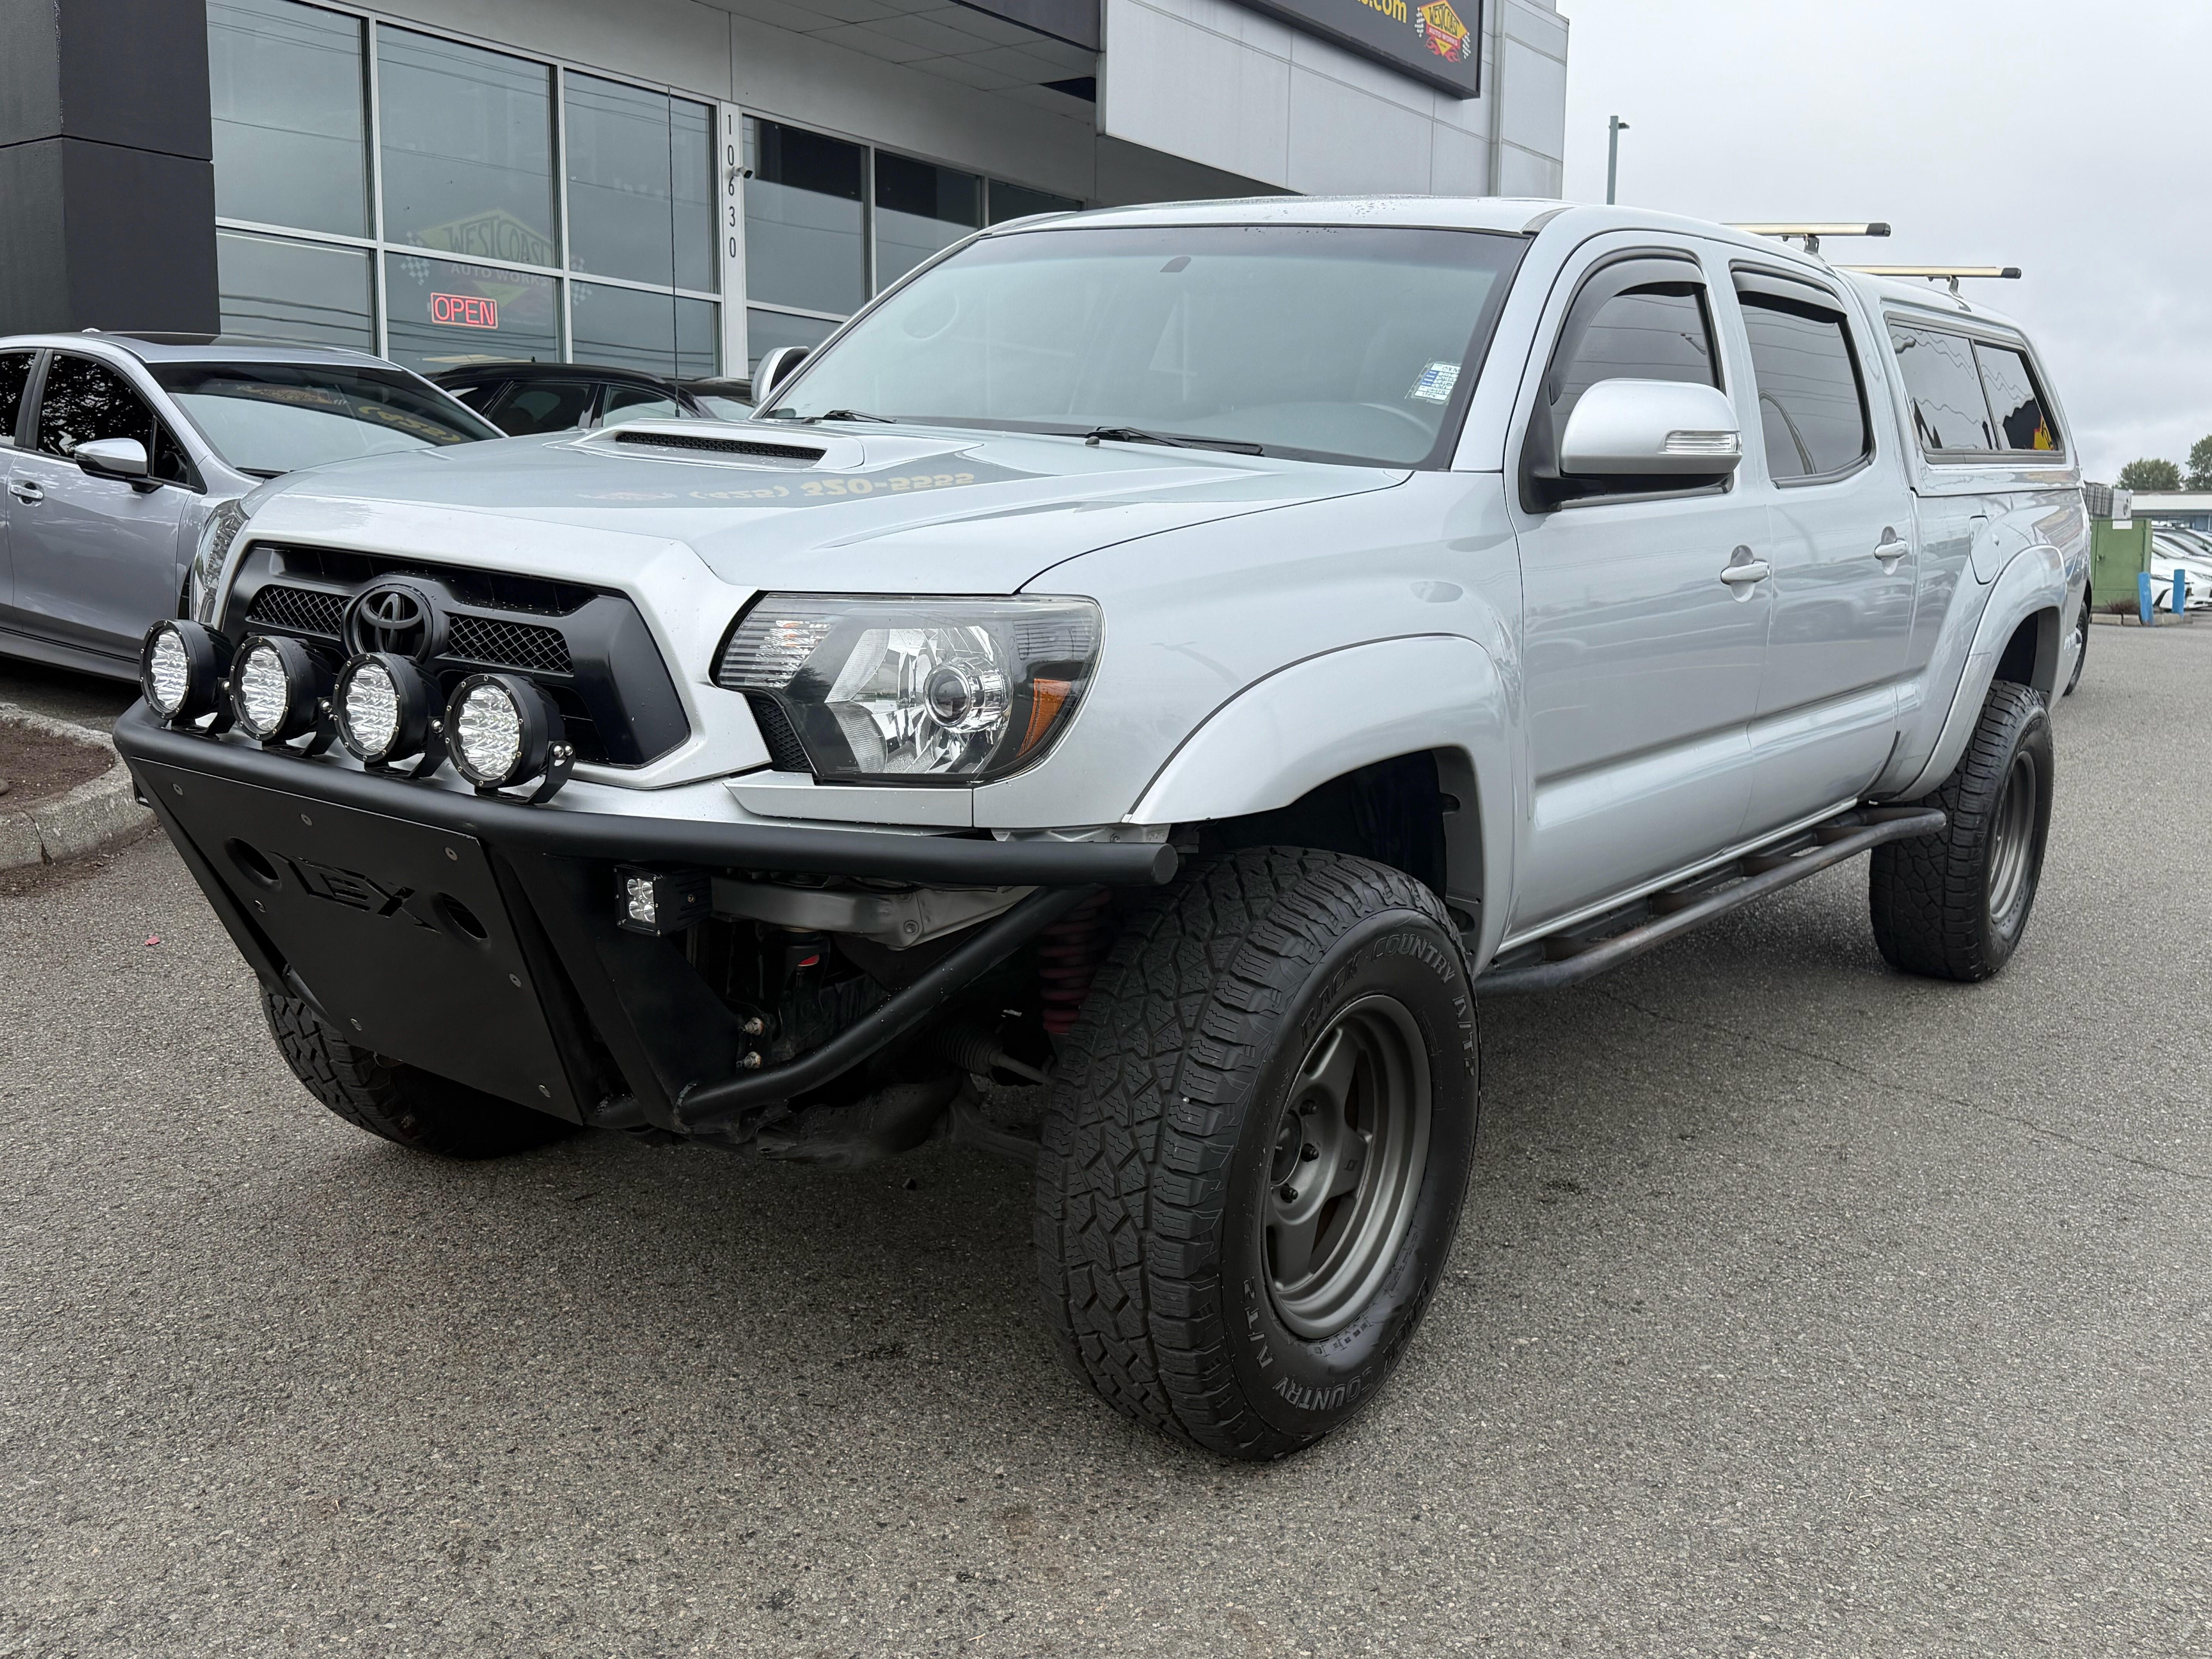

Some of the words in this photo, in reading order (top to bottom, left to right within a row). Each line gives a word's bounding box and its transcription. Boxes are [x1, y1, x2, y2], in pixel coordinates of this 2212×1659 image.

[1357, 0, 1407, 23] .com
[1429, 27, 1442, 38] AUTO
[1442, 33, 1458, 46] WORKS
[727, 114, 737, 258] 10630
[451, 264, 492, 278] AUTO
[496, 270, 549, 287] WORKS
[434, 296, 495, 326] OPEN
[1371, 933, 1457, 985] COUNTRY
[1272, 1366, 1374, 1412] COUNTRY
